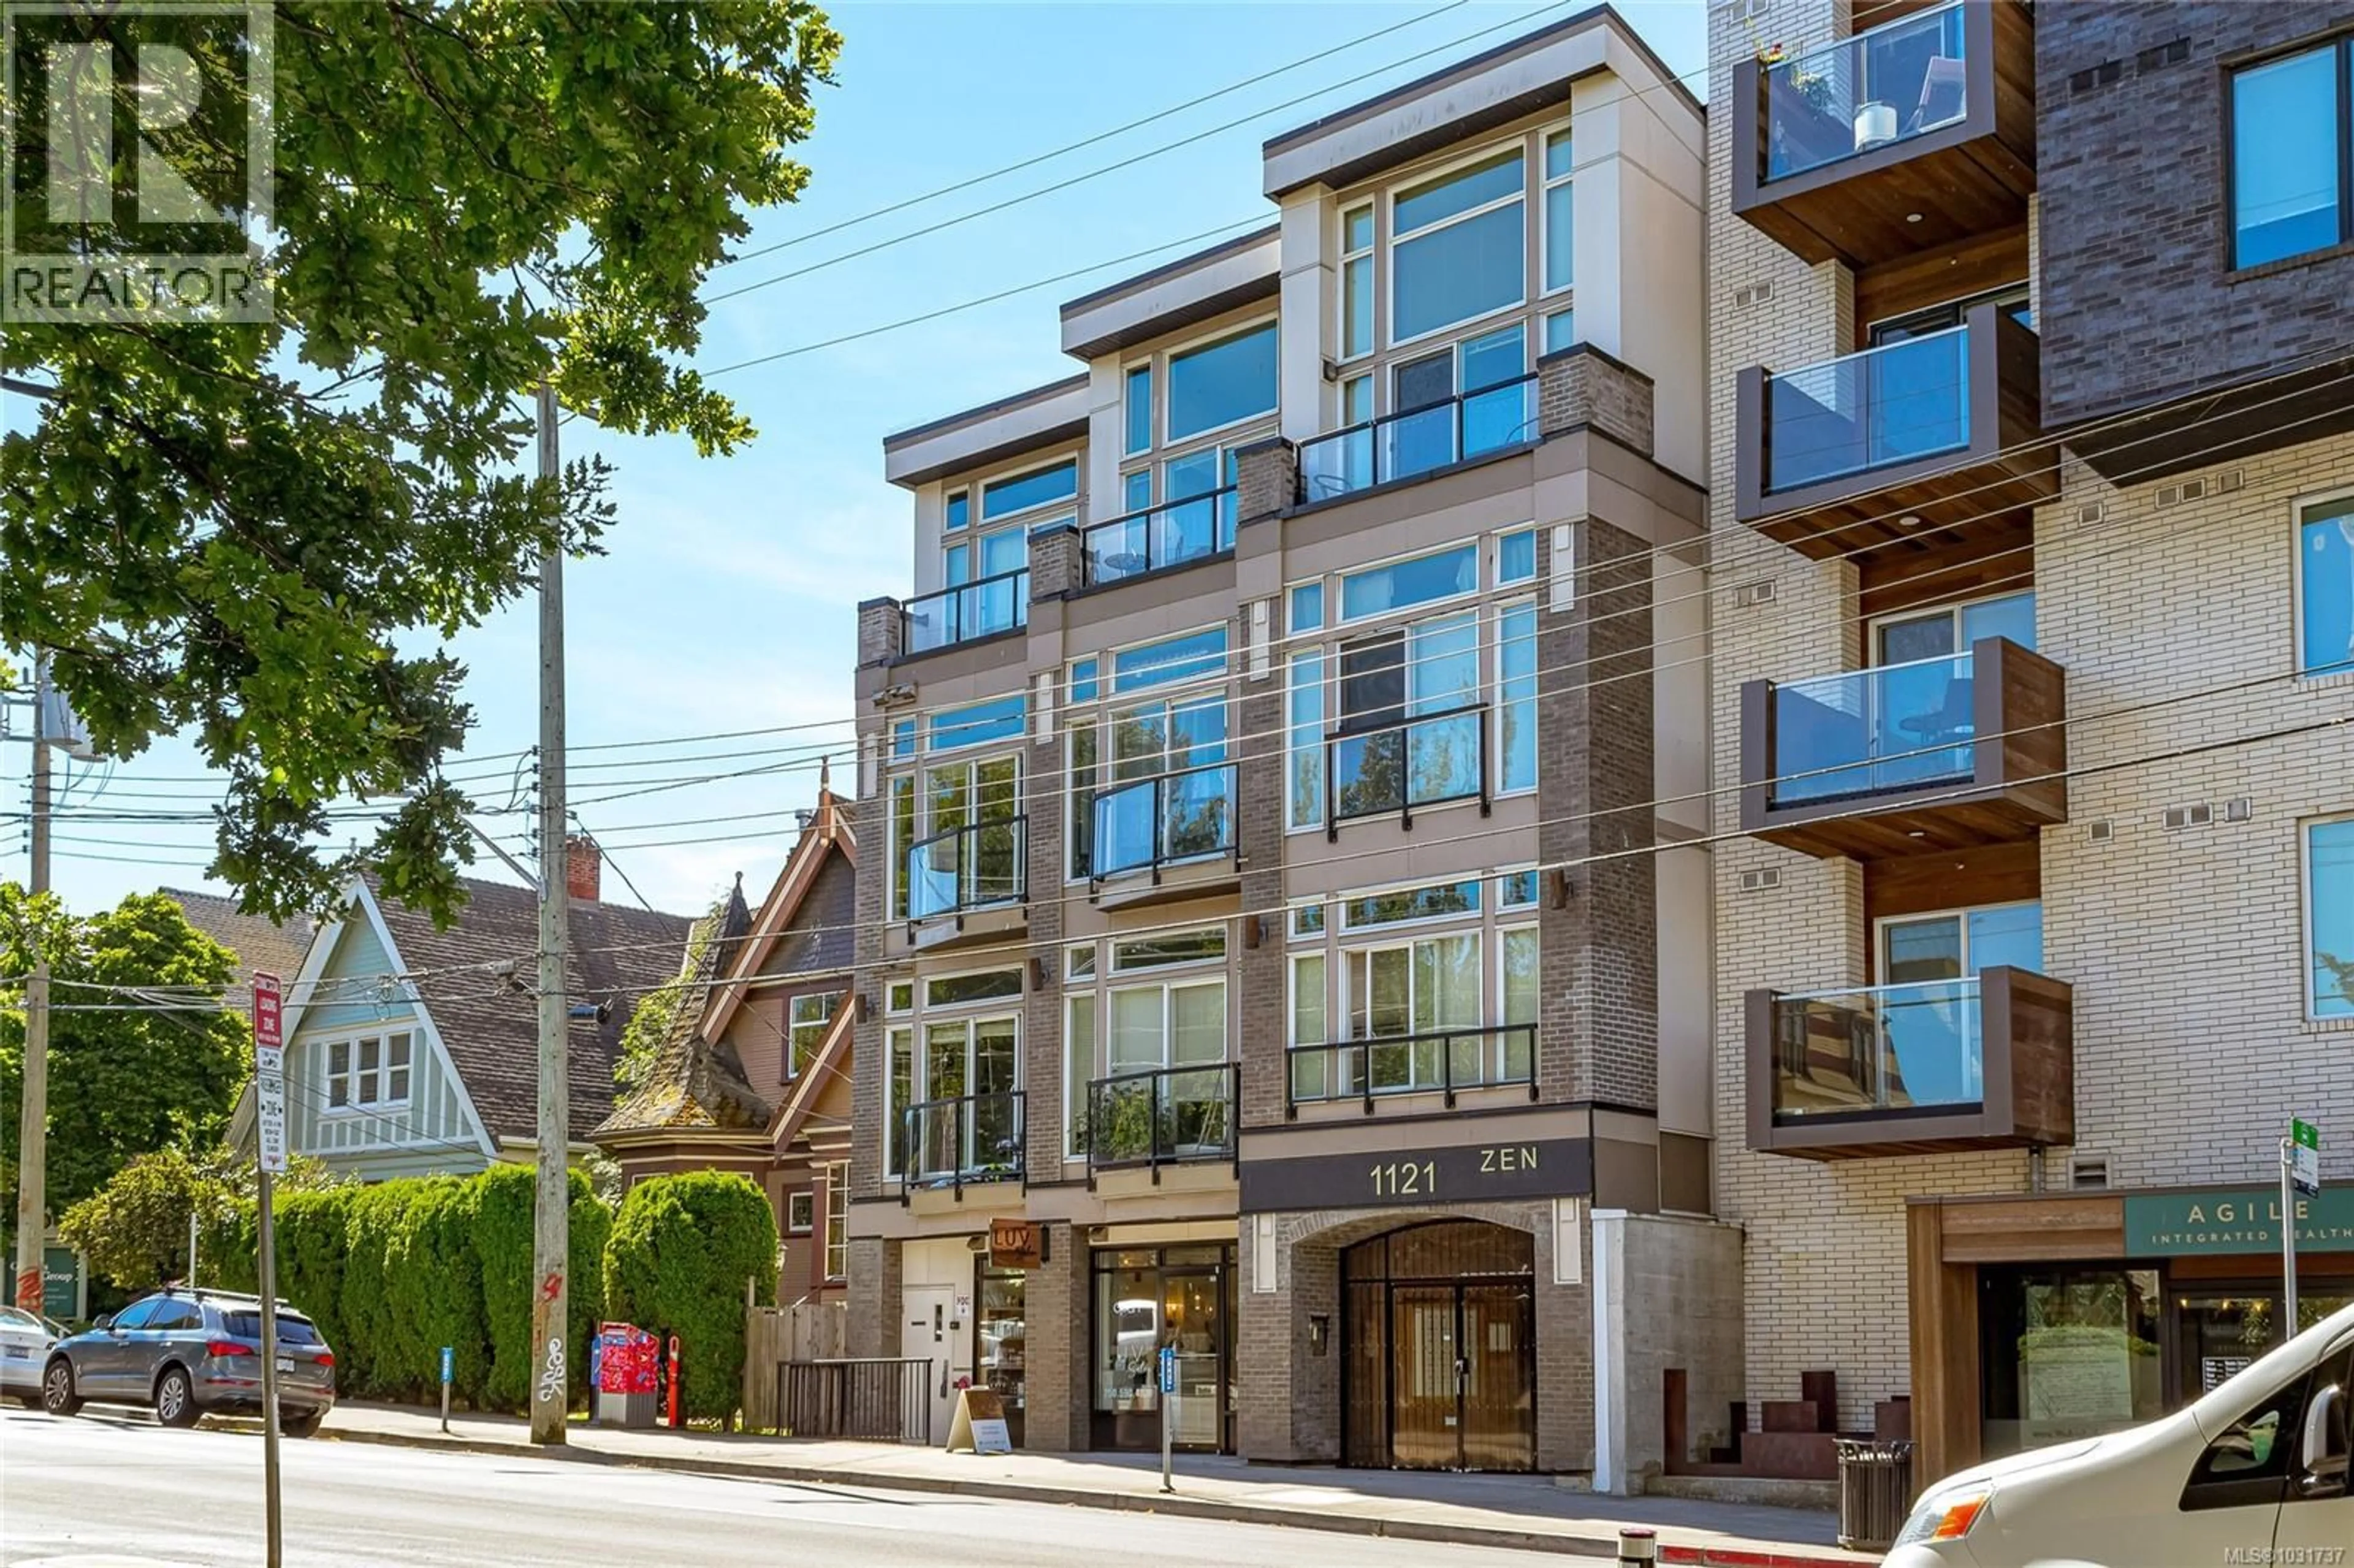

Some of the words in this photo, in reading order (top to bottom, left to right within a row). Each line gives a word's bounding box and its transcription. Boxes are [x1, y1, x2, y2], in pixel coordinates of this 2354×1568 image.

[1370, 1161, 1434, 1195] 1121
[1480, 1147, 1537, 1172] ZEN
[2187, 1200, 2308, 1224] AGILE
[994, 1228, 1030, 1247] LUV
[2152, 1230, 2268, 1244] INTEGRATED
[2280, 1228, 2353, 1239] EALTH
